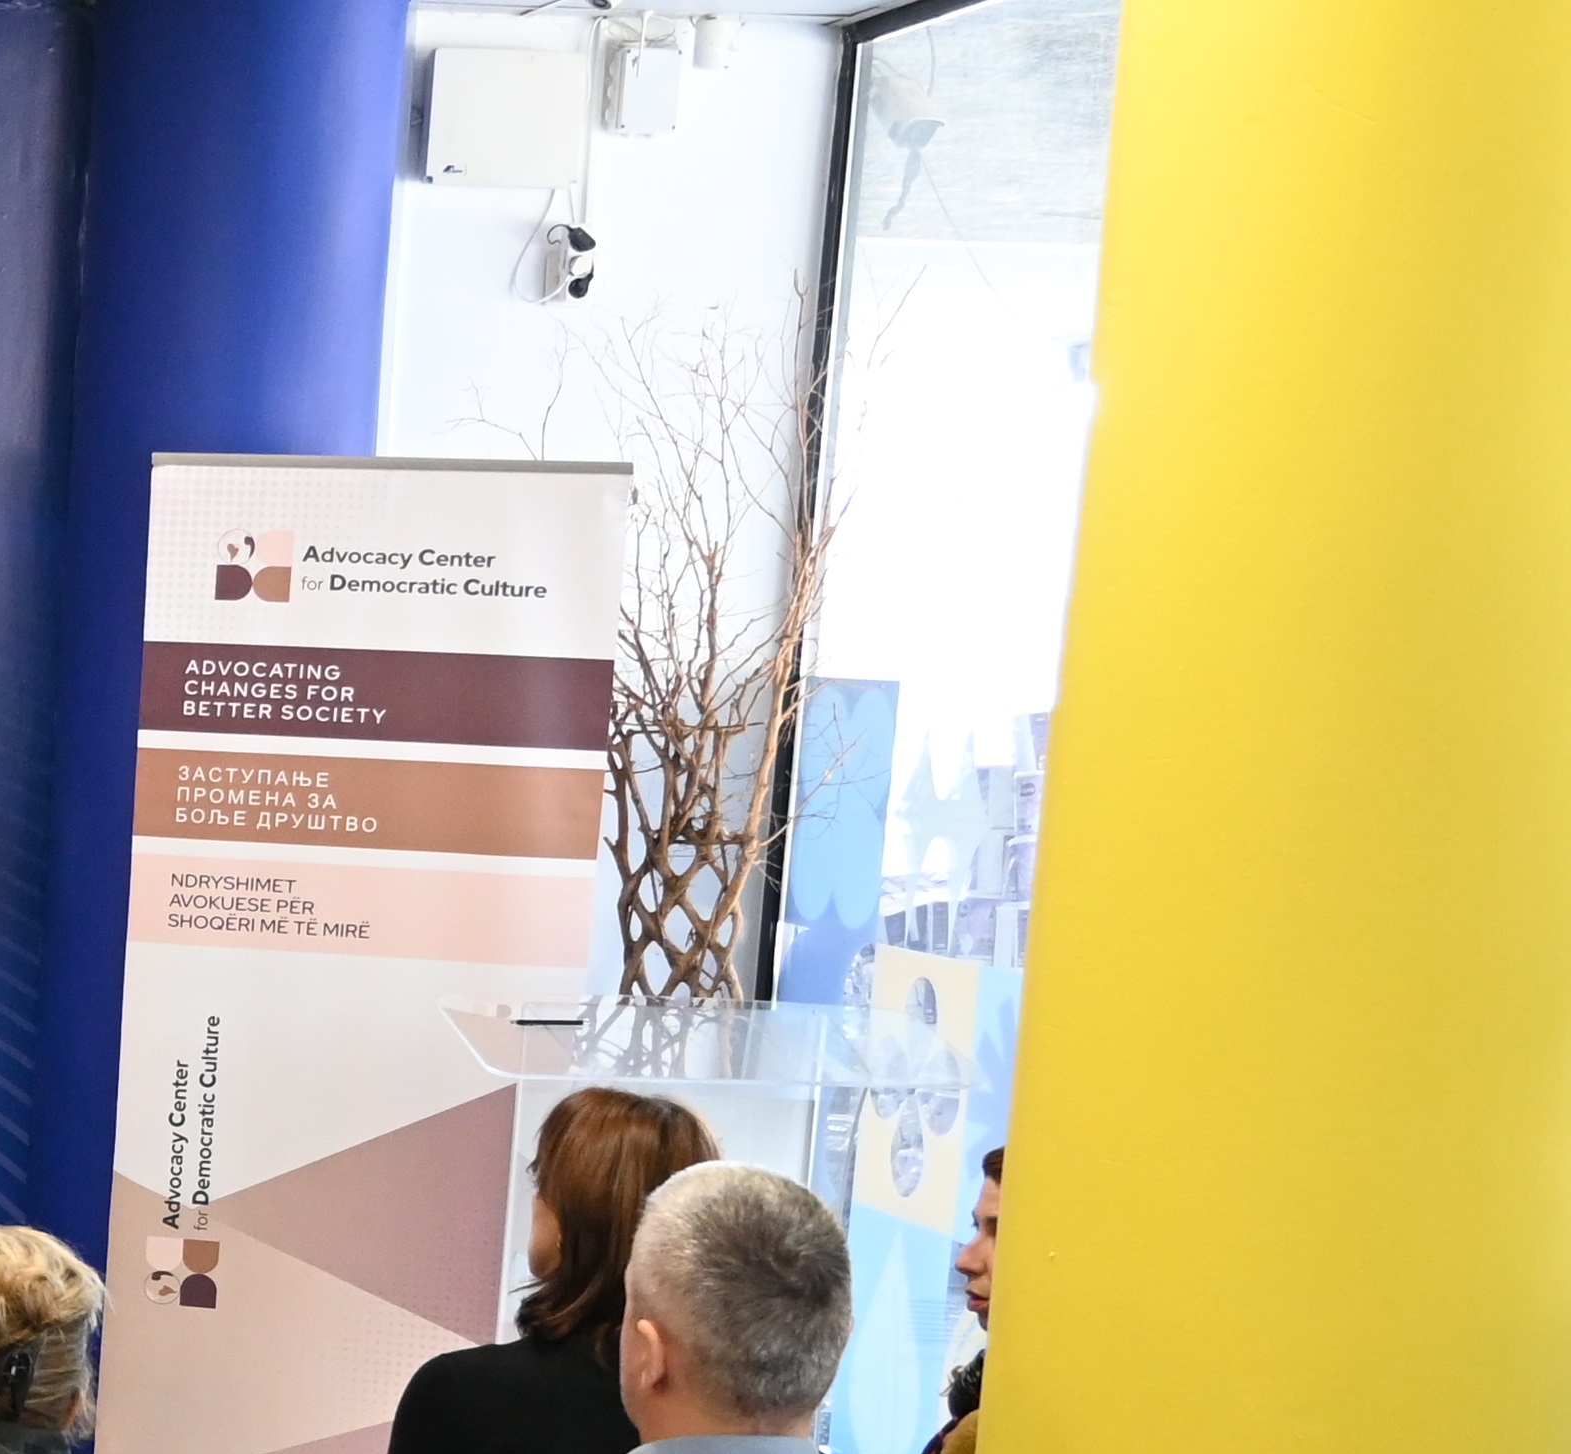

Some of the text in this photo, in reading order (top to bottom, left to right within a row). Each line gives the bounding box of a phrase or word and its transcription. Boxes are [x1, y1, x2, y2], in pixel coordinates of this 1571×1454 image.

[302, 545, 496, 570] Advocacy Center
[301, 574, 548, 598] for Democratic Culture
[184, 658, 341, 680] ADVOCATING
[183, 680, 355, 702] CHANGES FOR
[182, 700, 387, 725] BETTER SOCIETY
[177, 765, 330, 788] ЗАСТУПАЊЕ
[175, 787, 338, 809] ПРОМЕНА ЗА
[174, 807, 378, 834] БОЉЕ ДРУШТВО
[170, 873, 297, 893] NDRYSHIMET
[169, 893, 315, 915] AVOKUESE PËR
[167, 913, 371, 939] SHOQËRI MË TË MIRË
[191, 1014, 221, 1232] for Democratic Culture
[161, 1059, 190, 1230] Advocacy Center
